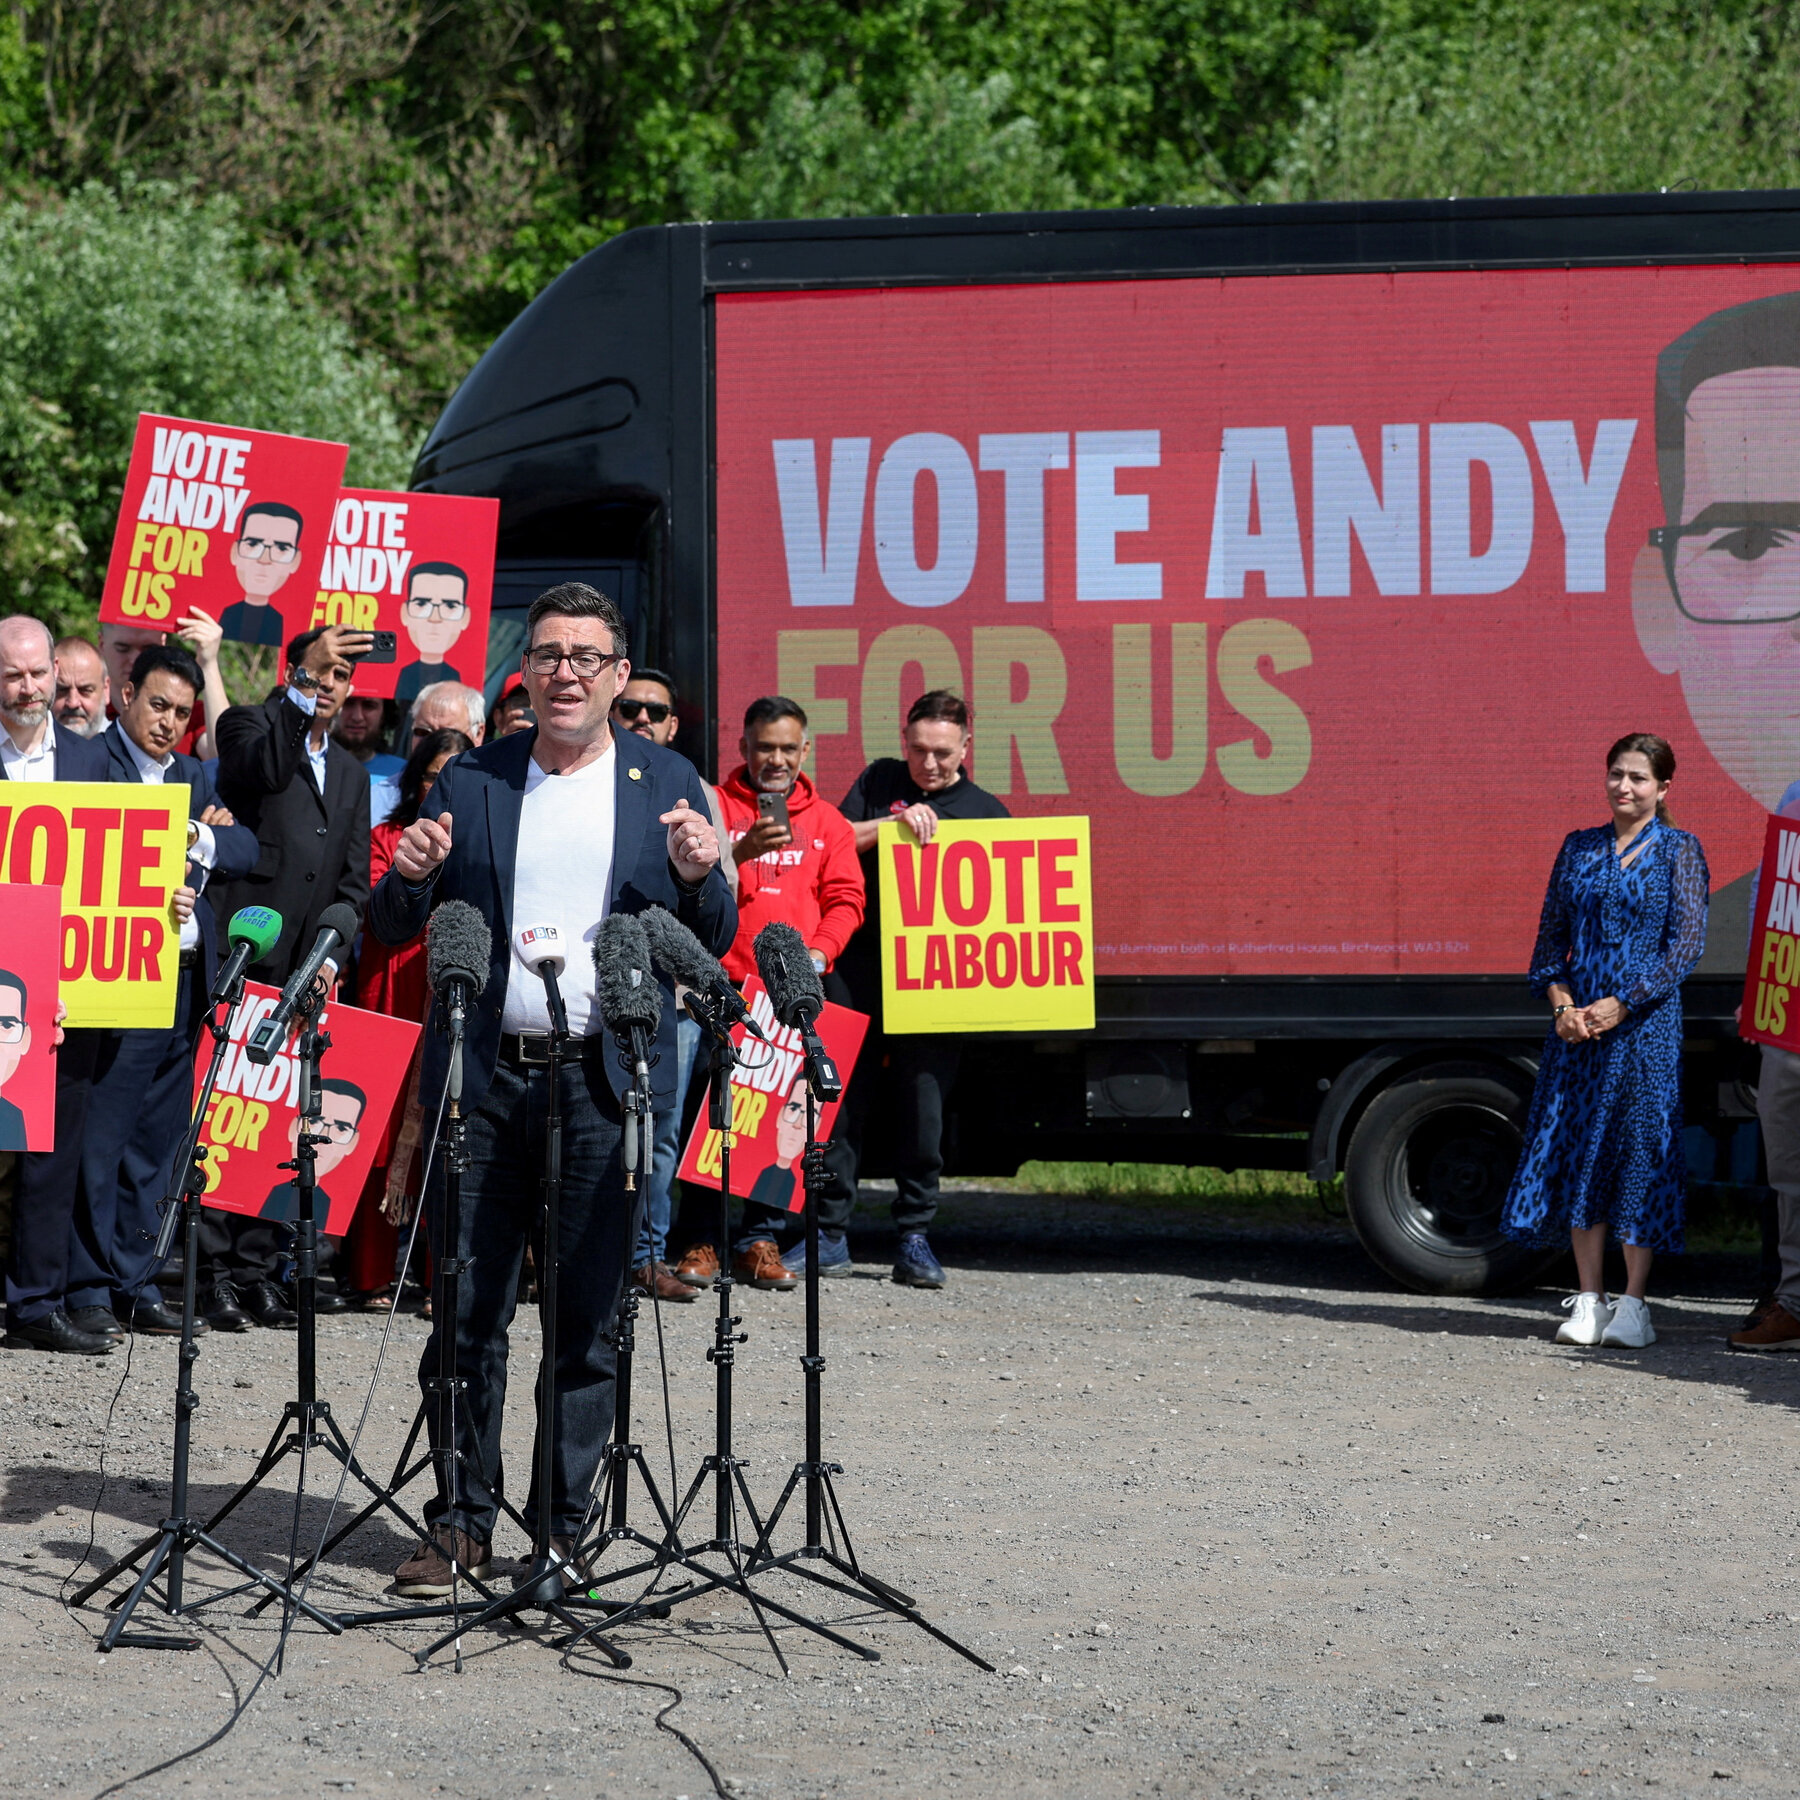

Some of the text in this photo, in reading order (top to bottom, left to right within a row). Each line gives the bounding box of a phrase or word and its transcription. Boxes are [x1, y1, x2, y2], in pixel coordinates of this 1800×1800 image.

[152, 426, 252, 487] VOTE
[137, 475, 251, 534] ANDY
[327, 497, 408, 548] OTE
[772, 418, 1639, 608] VOTE ANDY
[128, 522, 209, 577] FOR
[120, 569, 176, 620] US
[777, 617, 1313, 796] FOR US
[0, 804, 170, 908] OTE
[892, 838, 1081, 928] VOTE
[59, 914, 165, 982] OUR
[521, 926, 559, 946] LBC
[895, 930, 1085, 991] LABOUR
[1094, 944, 1116, 956] ndy
[1754, 980, 1790, 1036] US
[199, 1142, 230, 1194] S
